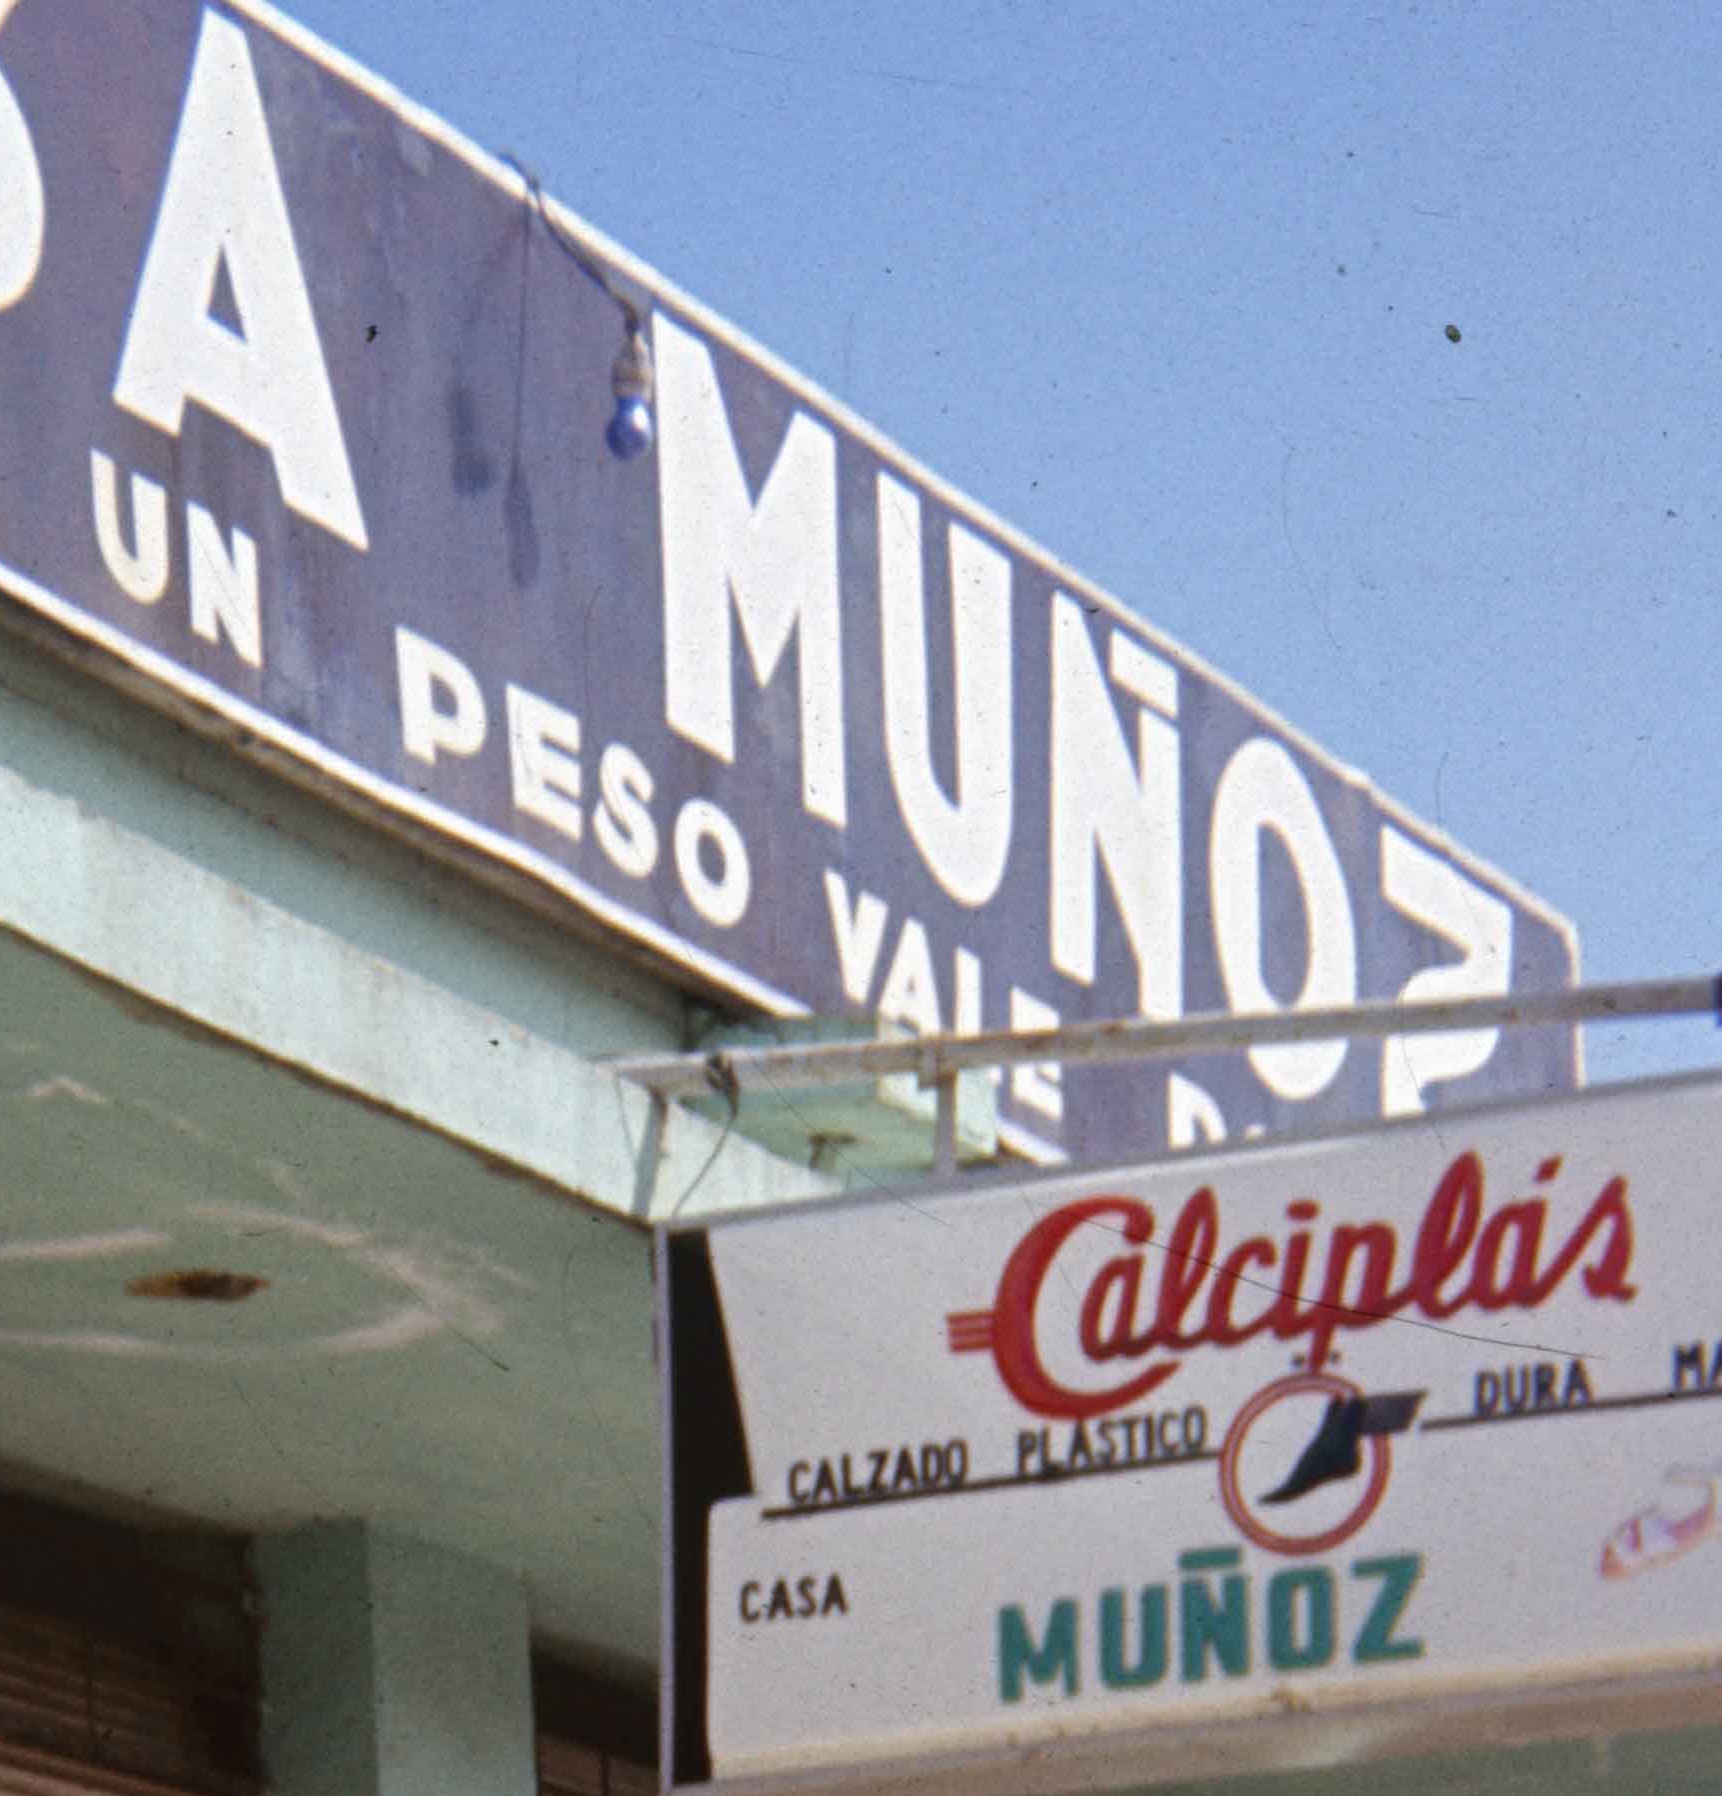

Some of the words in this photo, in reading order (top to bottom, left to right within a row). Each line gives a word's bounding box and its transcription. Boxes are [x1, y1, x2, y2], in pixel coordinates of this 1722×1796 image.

[90, 446, 264, 670] UN
[392, 622, 753, 929] PESO
[652, 305, 1514, 1118] MUÑOZ
[788, 1438, 969, 1503] CALZADO
[1014, 1405, 1209, 1478] PLASTICO
[1473, 1358, 1593, 1417] DURA
[739, 1573, 850, 1623] CASA
[998, 1546, 1426, 1704] MUÑOZ
